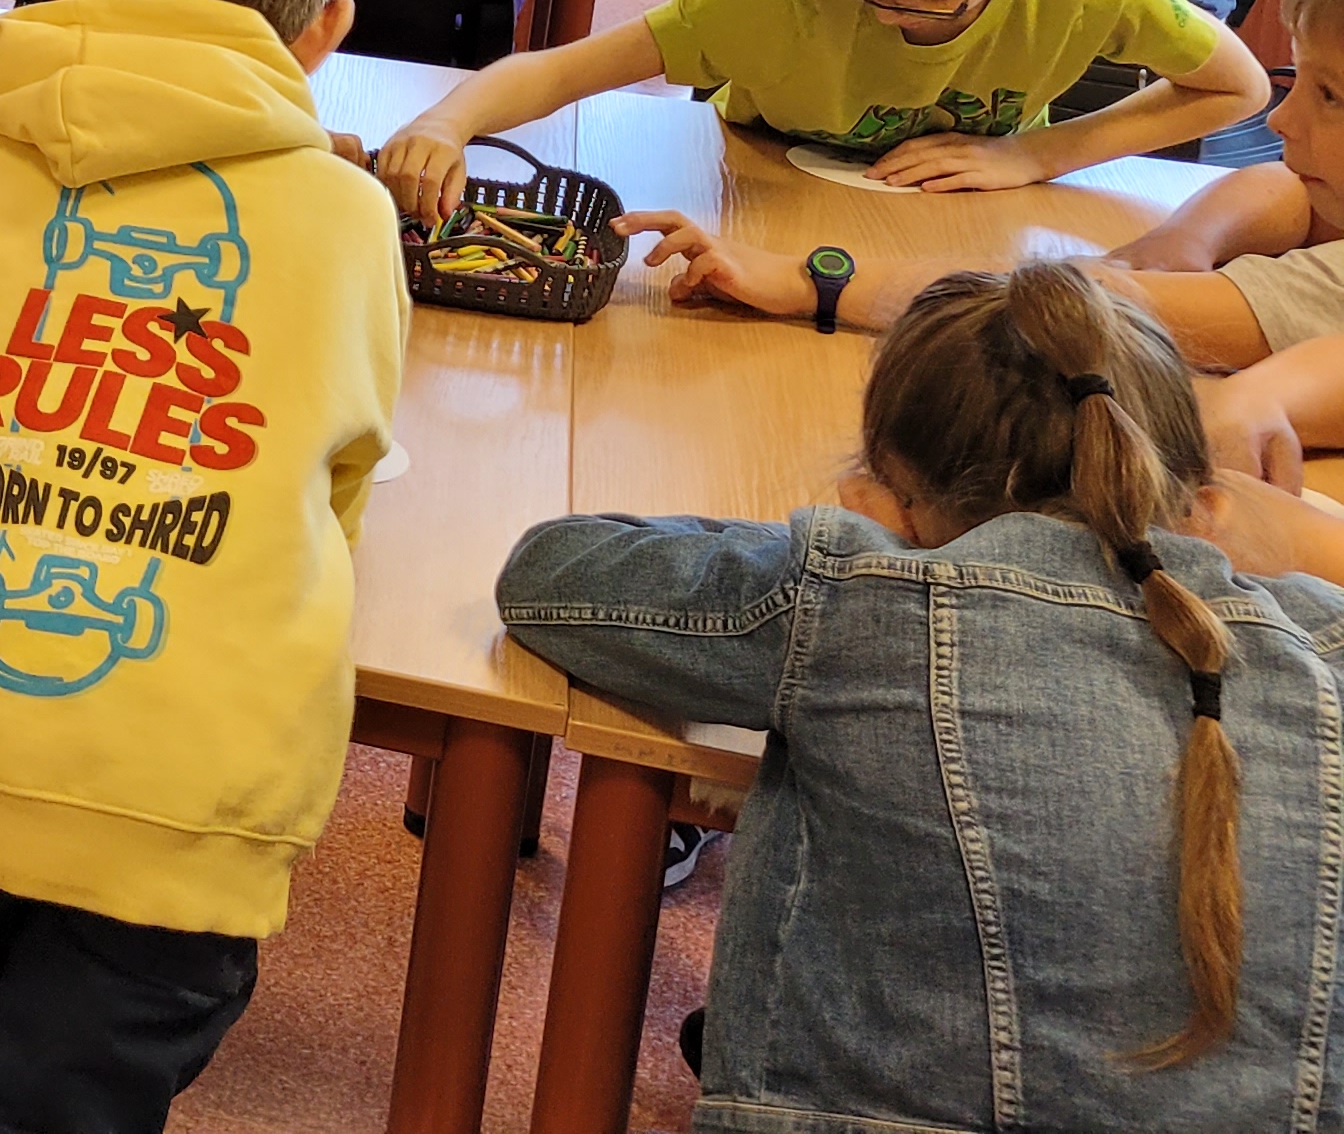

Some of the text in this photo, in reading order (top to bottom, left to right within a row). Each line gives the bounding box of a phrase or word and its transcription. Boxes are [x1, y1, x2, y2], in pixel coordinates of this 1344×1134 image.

[5, 287, 251, 397] LESS
[55, 443, 136, 485] 19/97
[56, 486, 103, 537] TO
[105, 490, 231, 565] SHRED
